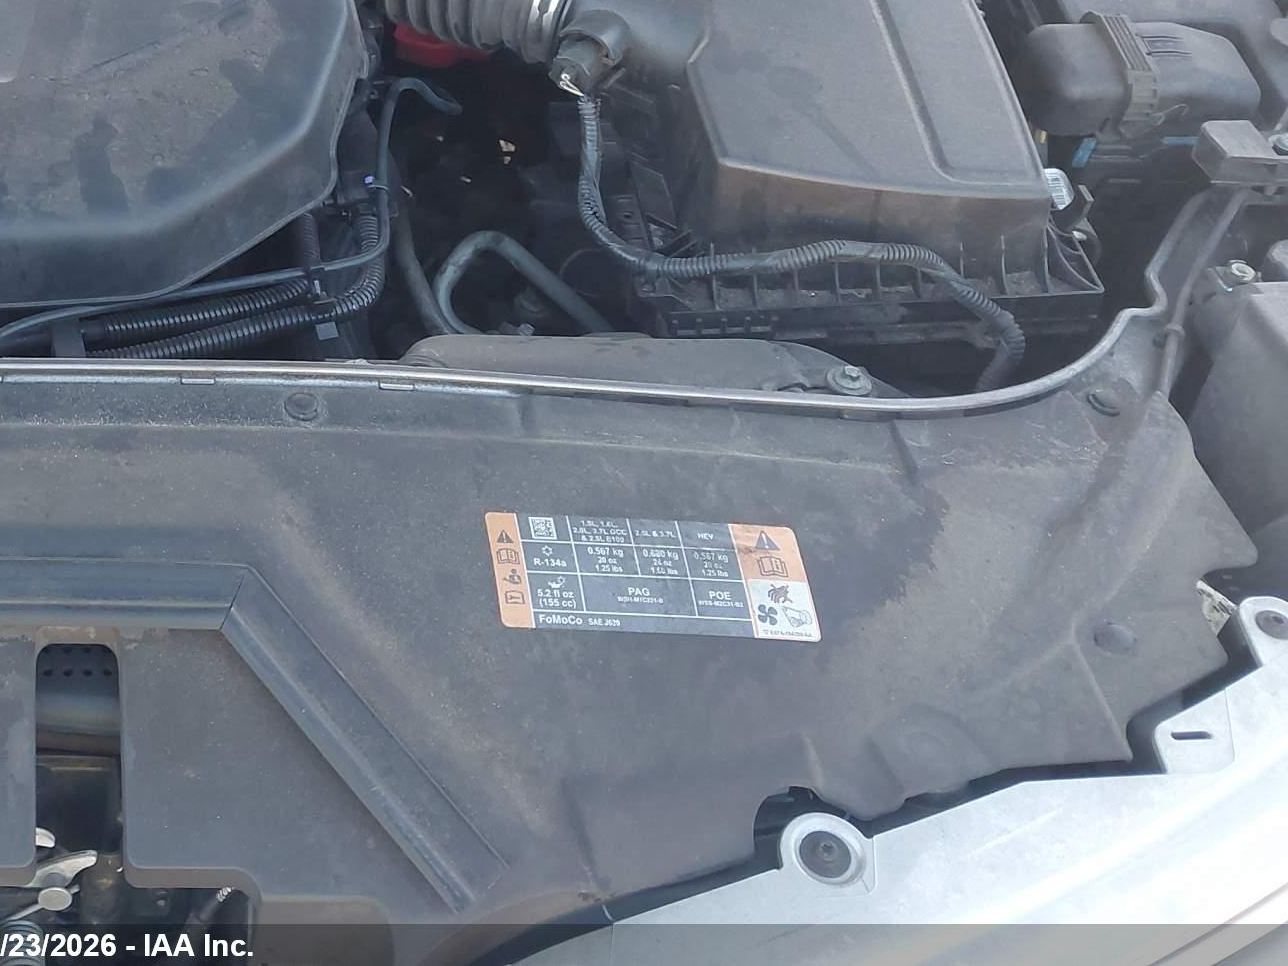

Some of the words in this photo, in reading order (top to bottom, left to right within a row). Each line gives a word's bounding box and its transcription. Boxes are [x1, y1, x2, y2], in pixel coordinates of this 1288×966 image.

[697, 532, 714, 540] HEV
[612, 547, 624, 557] kg
[667, 550, 679, 560] kg
[533, 557, 567, 568] R-134a
[718, 553, 729, 563] kg
[537, 589, 553, 598] 5.2
[627, 586, 651, 596] PAG
[708, 590, 732, 600] POE
[539, 598, 560, 608] (155
[561, 599, 577, 609] cc)
[539, 614, 583, 625] FoMoCo
[588, 618, 604, 626] SAE
